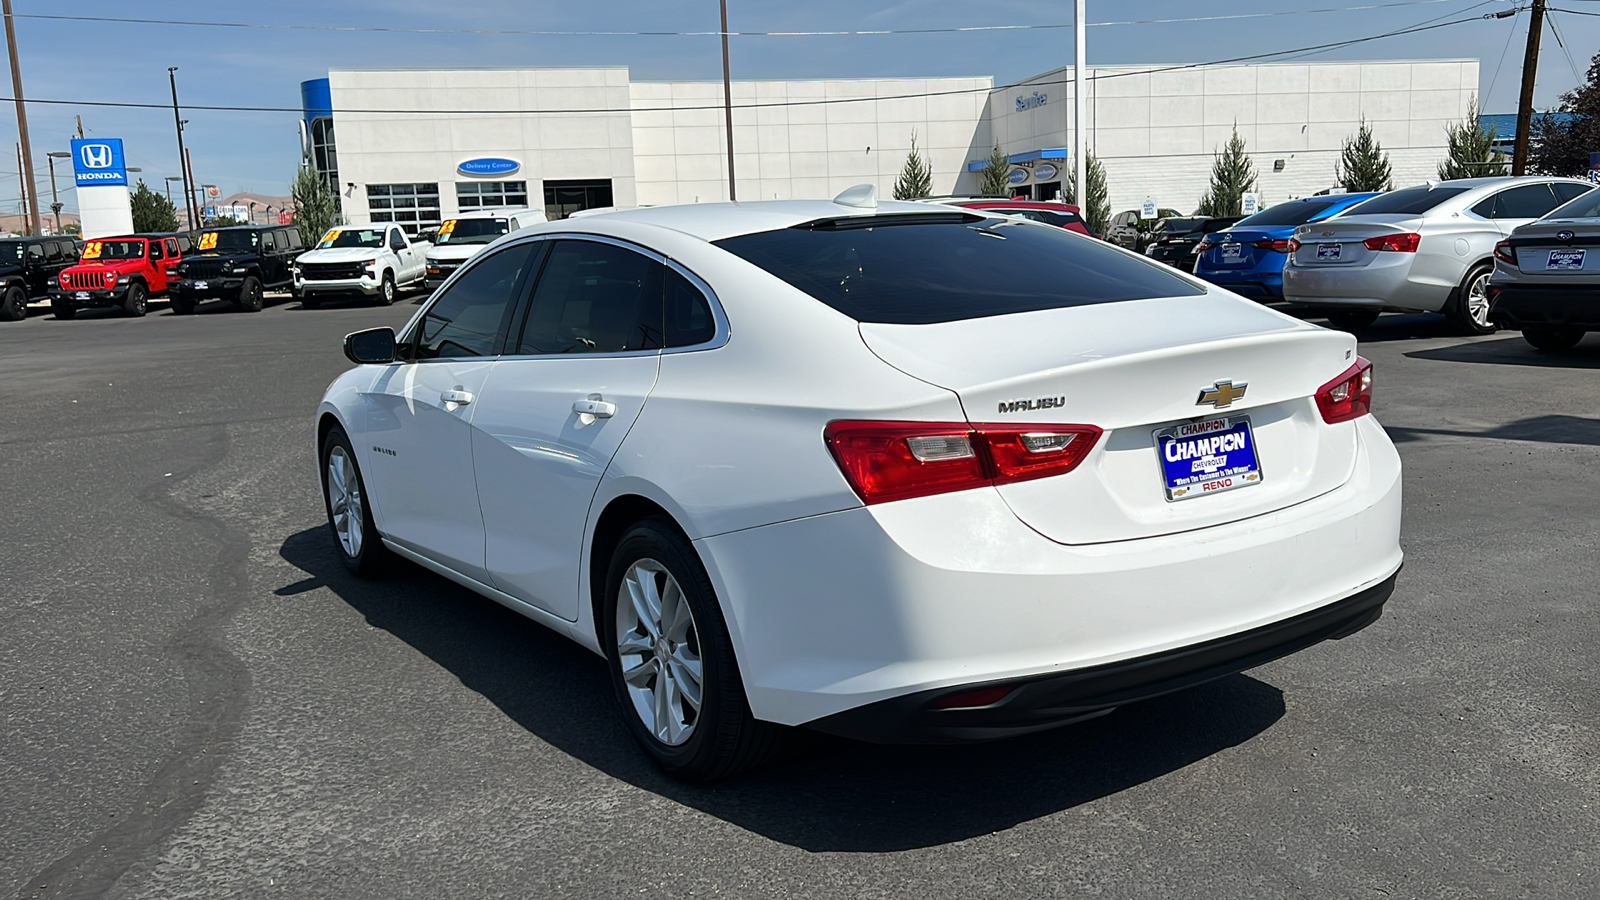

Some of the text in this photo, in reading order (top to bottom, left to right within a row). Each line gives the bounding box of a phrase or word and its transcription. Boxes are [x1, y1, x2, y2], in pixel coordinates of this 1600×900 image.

[1015, 91, 1047, 112] Service
[77, 172, 122, 180] HONDA
[201, 232, 217, 244] 20
[1551, 252, 1583, 260] CHAMPION
[998, 396, 1066, 414] MALIBU
[1181, 420, 1225, 435] CHAMPION
[1165, 432, 1245, 462] CHAMPION
[1193, 457, 1226, 470] CHEVROLET
[1190, 474, 1199, 483] The
[1202, 478, 1232, 491] RENO
